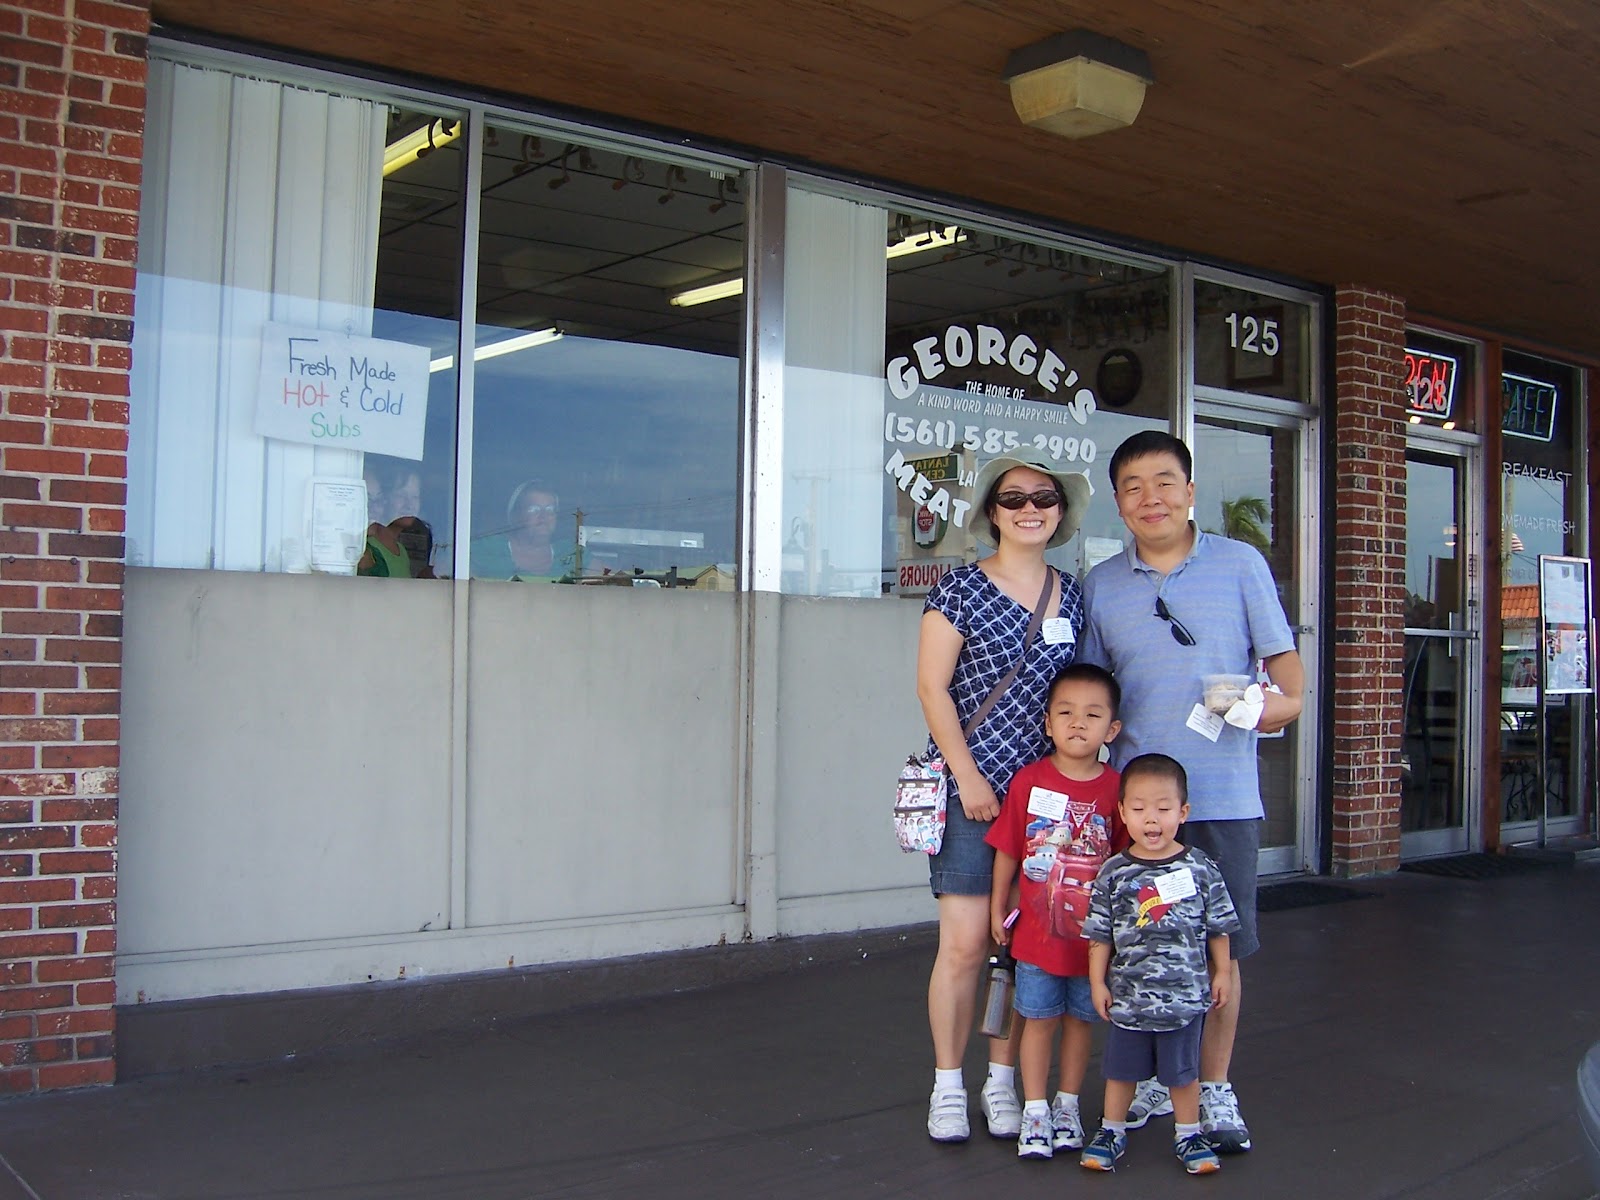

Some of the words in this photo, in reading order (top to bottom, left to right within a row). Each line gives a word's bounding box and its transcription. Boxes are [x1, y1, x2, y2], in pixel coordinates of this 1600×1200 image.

[1225, 312, 1279, 356] 125
[288, 338, 337, 380] Fresh
[350, 356, 396, 382] Made
[887, 324, 1097, 426] GEORGE'S
[339, 385, 350, 409] &
[360, 386, 404, 415] Cold
[965, 380, 983, 396] THE
[984, 383, 1011, 400] HOME
[1012, 387, 1026, 401] OF
[1409, 376, 1447, 412] 123
[311, 411, 361, 438] Subs
[917, 393, 925, 406] A
[927, 393, 951, 409] KIND
[953, 397, 981, 414] WORD
[983, 402, 1003, 417] AND
[1004, 403, 1011, 418] A
[1013, 405, 1042, 422] HAPPY
[1043, 409, 1068, 425] SMILE
[885, 412, 956, 449] (561)
[962, 425, 1097, 464] 585-2990
[885, 448, 971, 528] MEAT
[1546, 518, 1576, 536] FRESH
